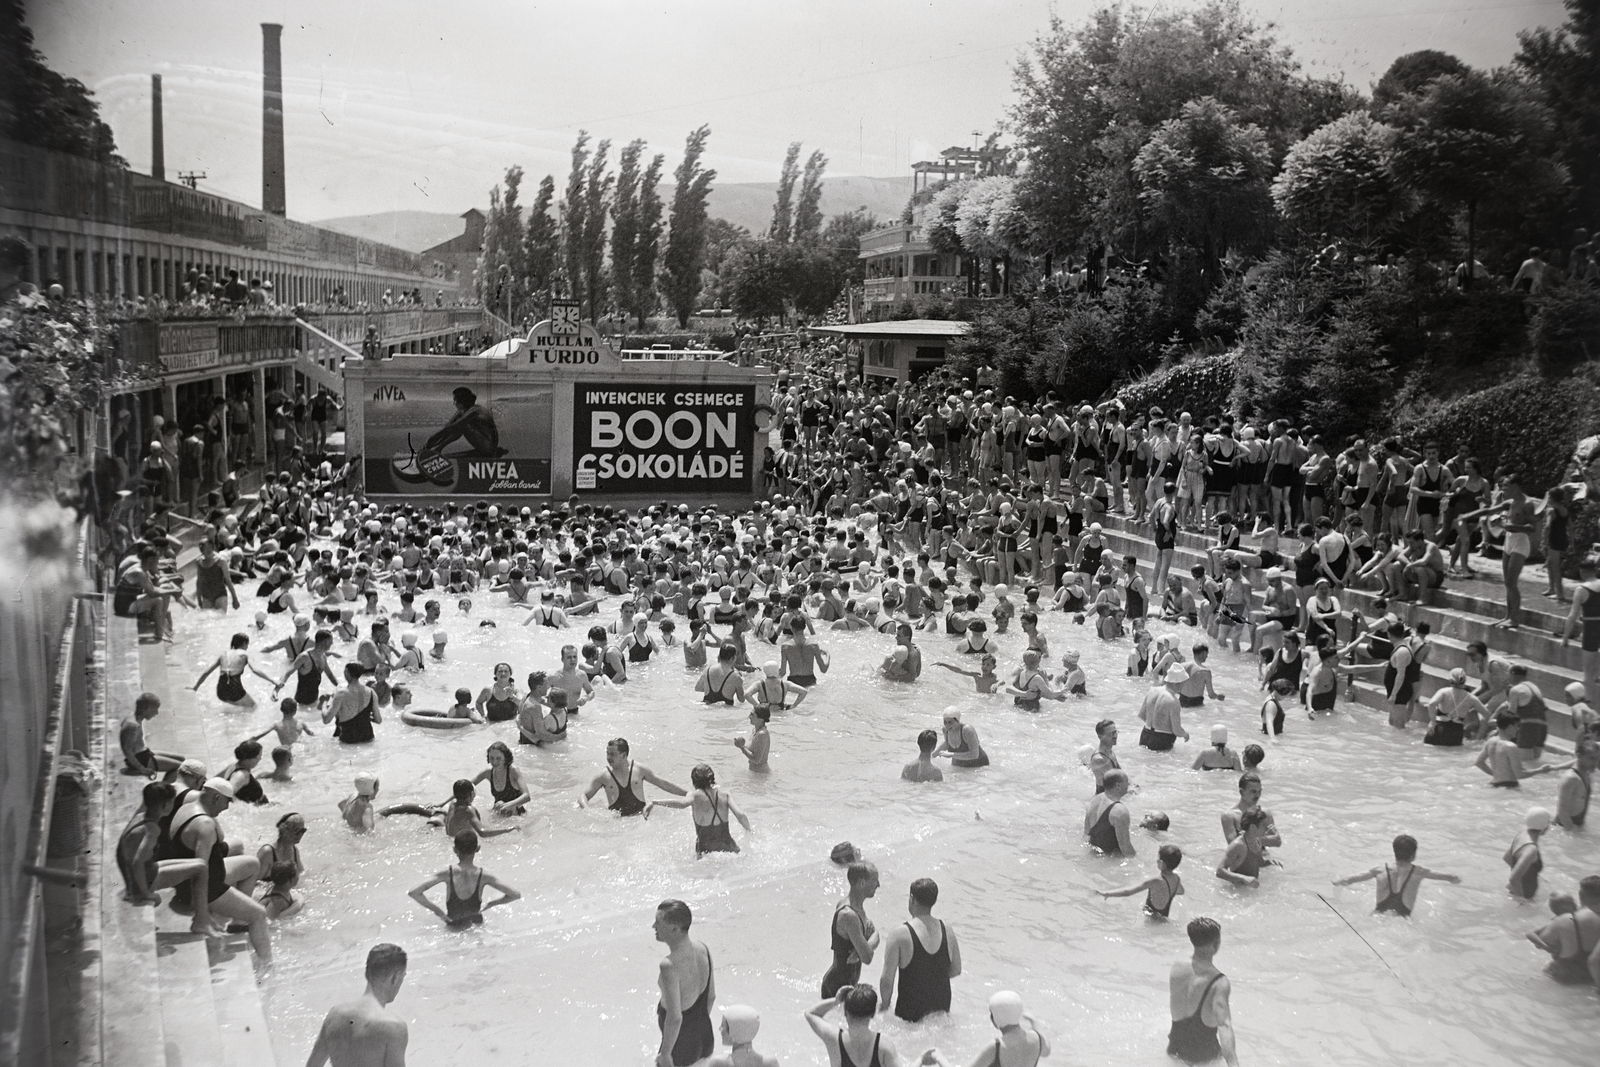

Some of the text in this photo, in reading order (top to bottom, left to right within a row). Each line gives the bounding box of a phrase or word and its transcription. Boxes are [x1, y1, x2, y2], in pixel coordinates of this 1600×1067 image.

[373, 384, 406, 401] NIVEA
[585, 391, 744, 406] INYENCNEK CSEMEGE
[591, 409, 737, 449] BOON
[468, 461, 519, 479] NIVEA
[578, 450, 744, 479] CSOKOLÁDÉ
[488, 480, 518, 492] jobban
